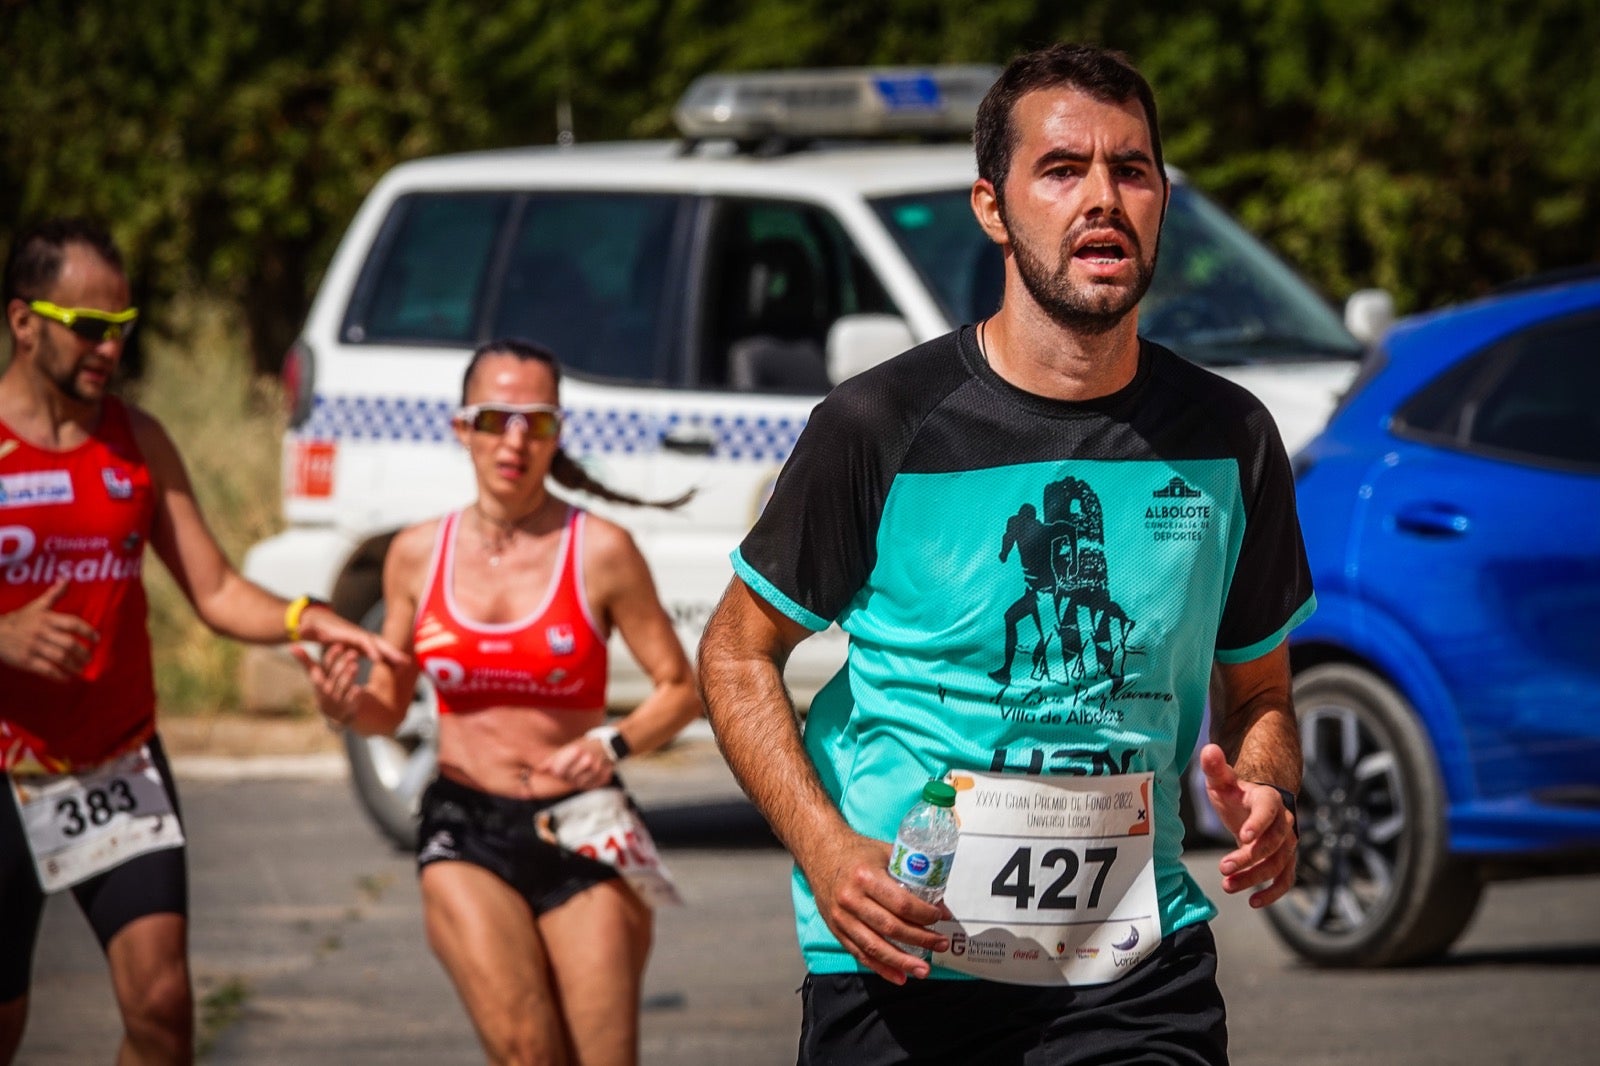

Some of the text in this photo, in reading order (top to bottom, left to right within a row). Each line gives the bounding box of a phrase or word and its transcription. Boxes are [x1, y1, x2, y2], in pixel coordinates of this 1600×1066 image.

[1145, 506, 1210, 518] ALBOLOTE
[1153, 531, 1202, 541] DEPORTES
[1001, 706, 1036, 723] Villa
[1040, 711, 1062, 724] de
[56, 779, 137, 837] 383
[976, 790, 1002, 808] XXXV
[1113, 790, 1134, 810] 2022
[991, 846, 1118, 910] 427
